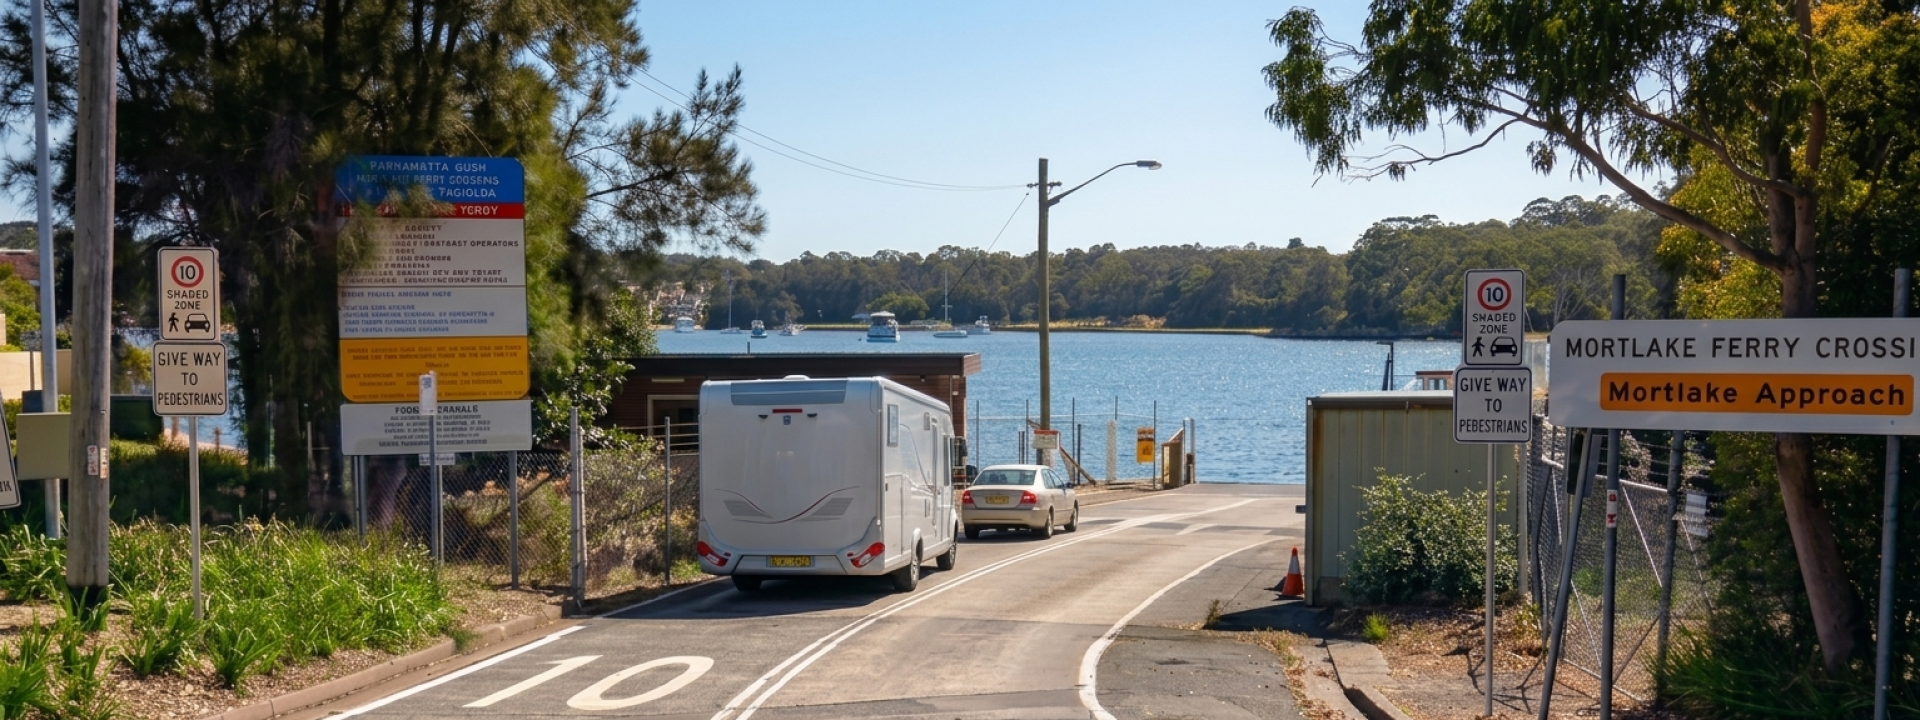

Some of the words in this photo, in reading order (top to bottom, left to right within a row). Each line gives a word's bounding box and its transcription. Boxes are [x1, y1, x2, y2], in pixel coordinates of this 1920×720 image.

[455, 163, 487, 172] GUSH
[179, 265, 196, 280] 10
[1485, 286, 1504, 303] 10
[1479, 324, 1508, 334] ZONE
[1566, 337, 1697, 358] MORTLAKE
[1711, 337, 1800, 358] FERRY
[1815, 336, 1915, 359] CROSSI
[158, 352, 188, 366] GIVE
[193, 352, 221, 366] WAY
[181, 372, 198, 386] TO
[1460, 377, 1492, 392] GIVE
[1497, 377, 1527, 392] WAY
[157, 392, 224, 406] PEDESTRIANS
[1609, 381, 1738, 403] Mortlake
[1755, 382, 1905, 409] Approach
[1484, 398, 1502, 413] TO
[462, 654, 715, 711] 10
